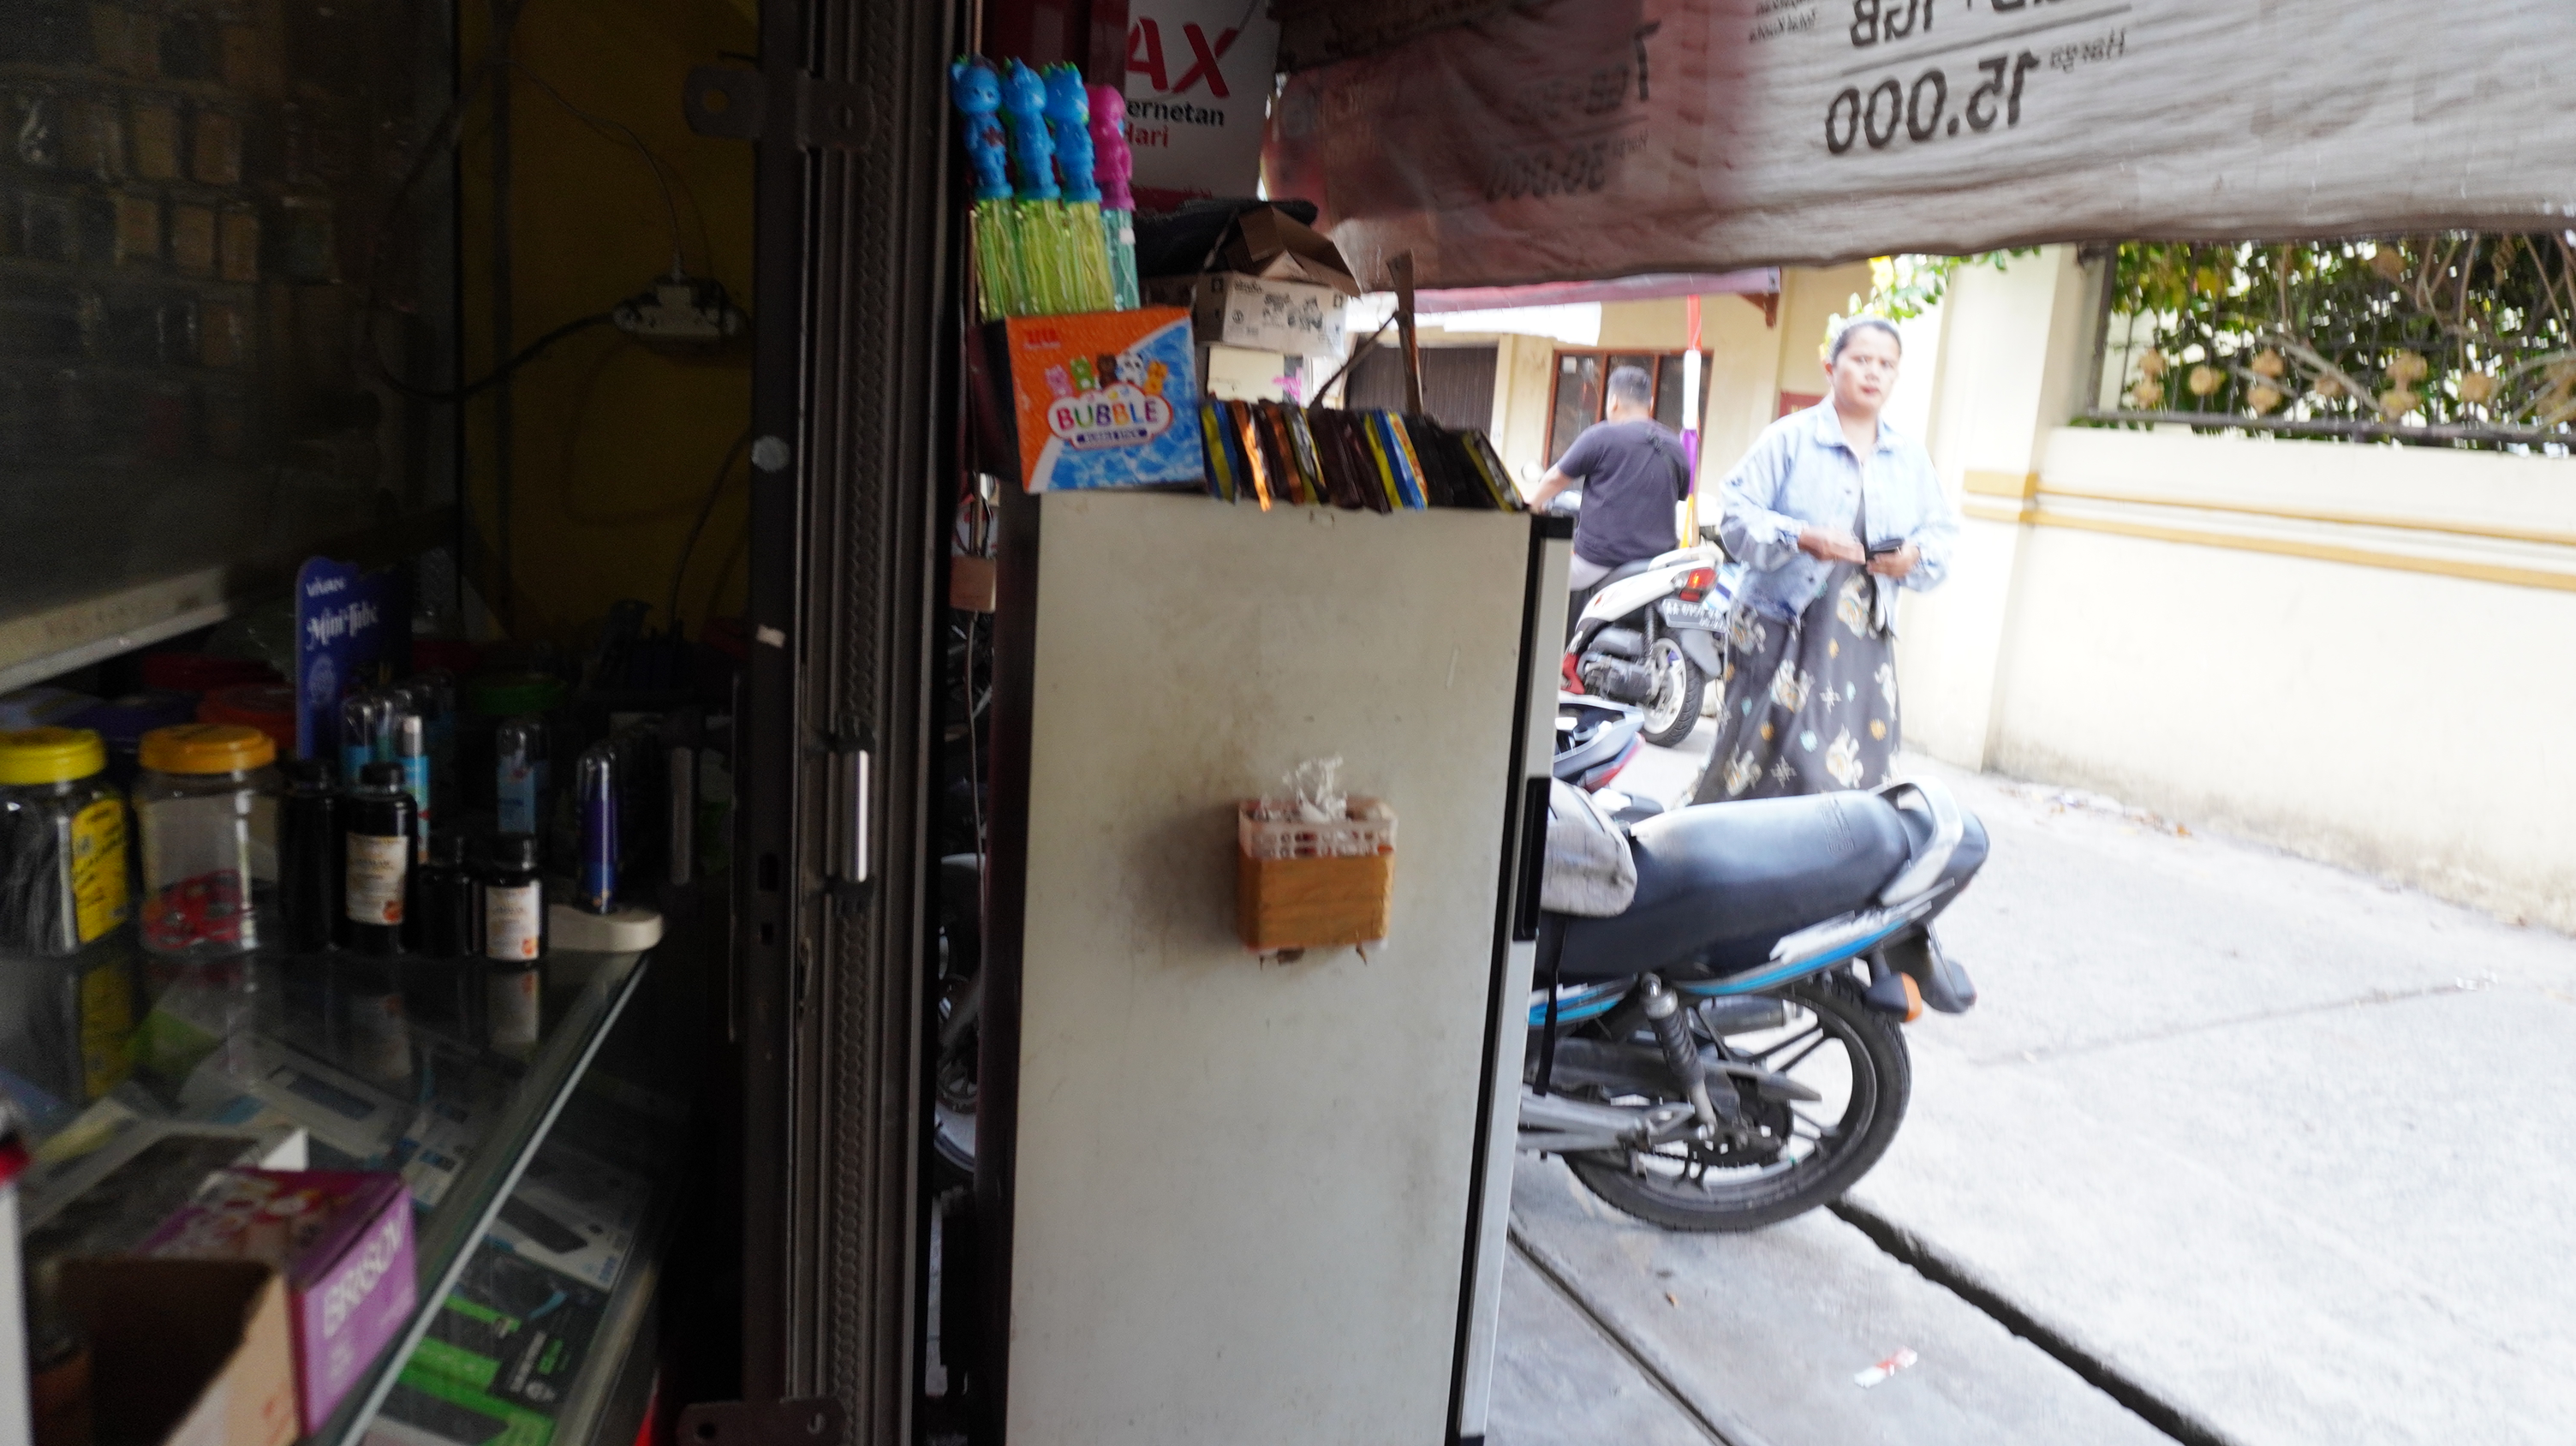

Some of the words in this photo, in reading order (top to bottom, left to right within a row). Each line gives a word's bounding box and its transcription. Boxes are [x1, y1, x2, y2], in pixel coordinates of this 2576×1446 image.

[1126, 16, 1239, 99] AX
[1127, 100, 1225, 128] ernetan
[1056, 399, 1158, 431] BUBBLE
